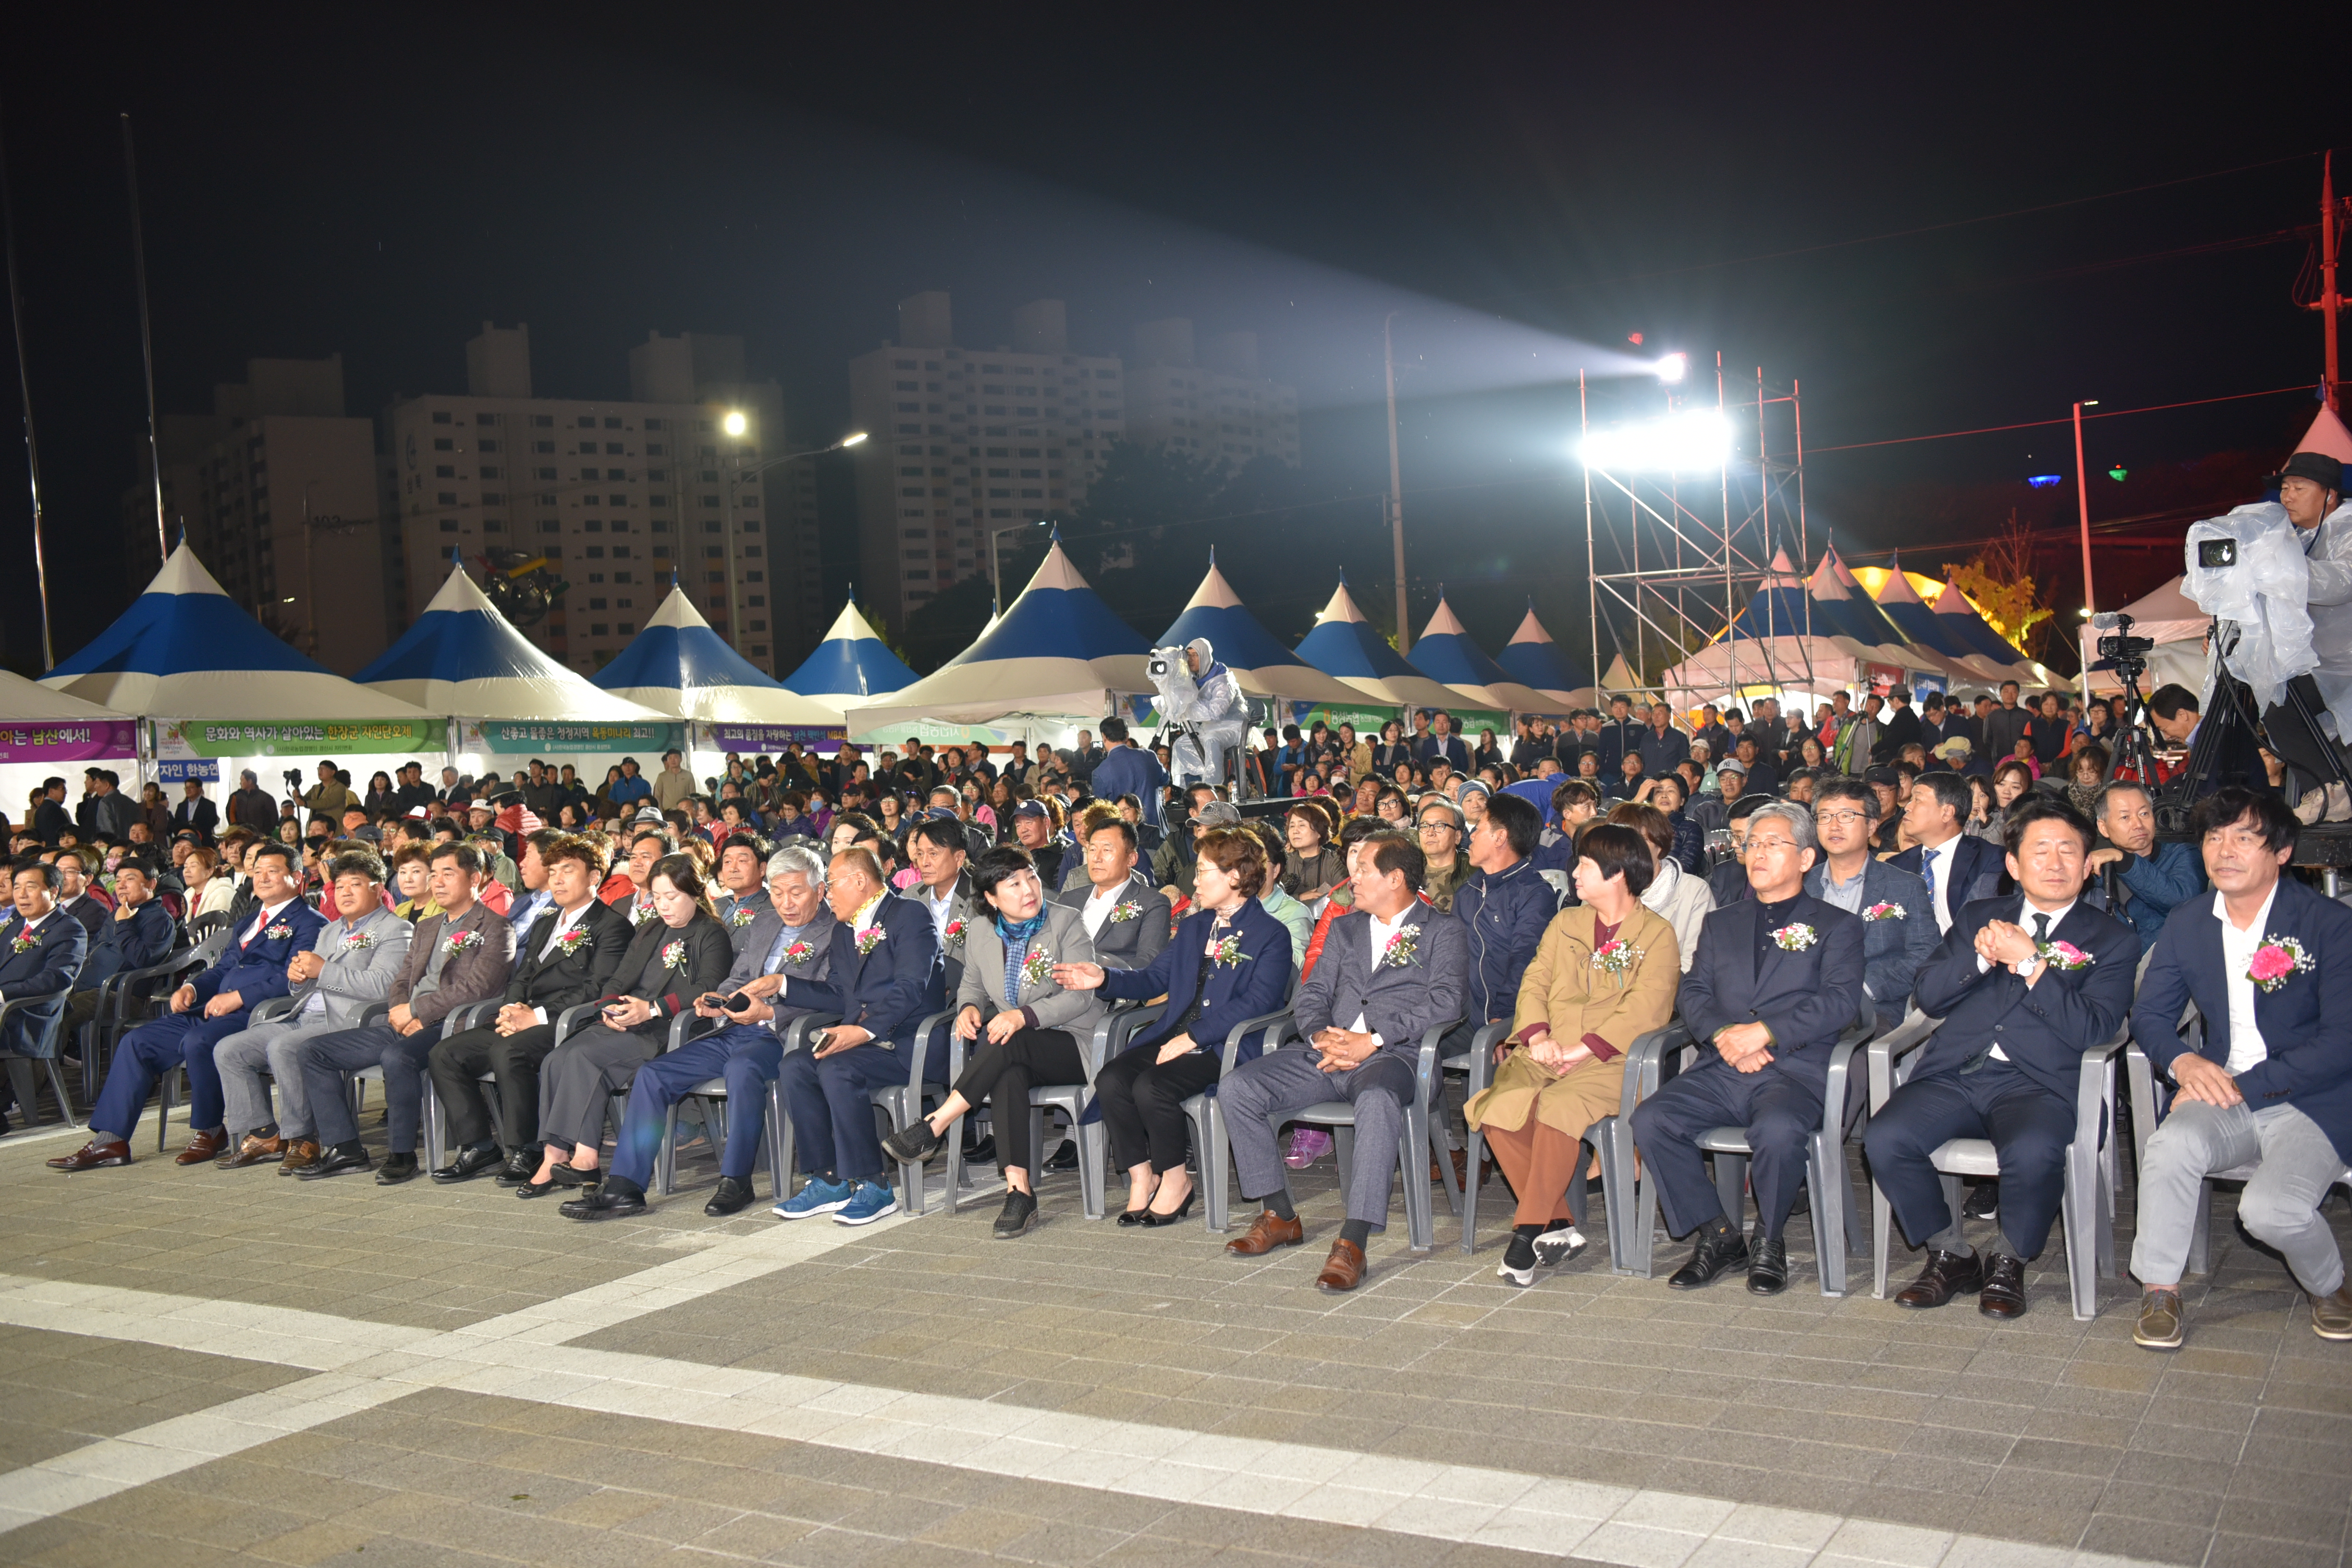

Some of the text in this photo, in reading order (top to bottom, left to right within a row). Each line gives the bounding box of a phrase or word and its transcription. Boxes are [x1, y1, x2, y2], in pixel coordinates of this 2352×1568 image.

[1331, 710, 1359, 725] 용성농협
[32, 728, 91, 746] 남산에서!
[205, 725, 412, 742] 문화와 역사가 살아있는 한장군 자인단오제
[501, 726, 655, 740] 산좋고 물좋은 청정지역 육동미나리 최고!!
[724, 728, 744, 740] 최고의
[745, 728, 764, 741] 품질을
[766, 729, 792, 741] 자랑하는
[793, 729, 806, 741] 남천
[160, 763, 219, 777] 자인 한농연
